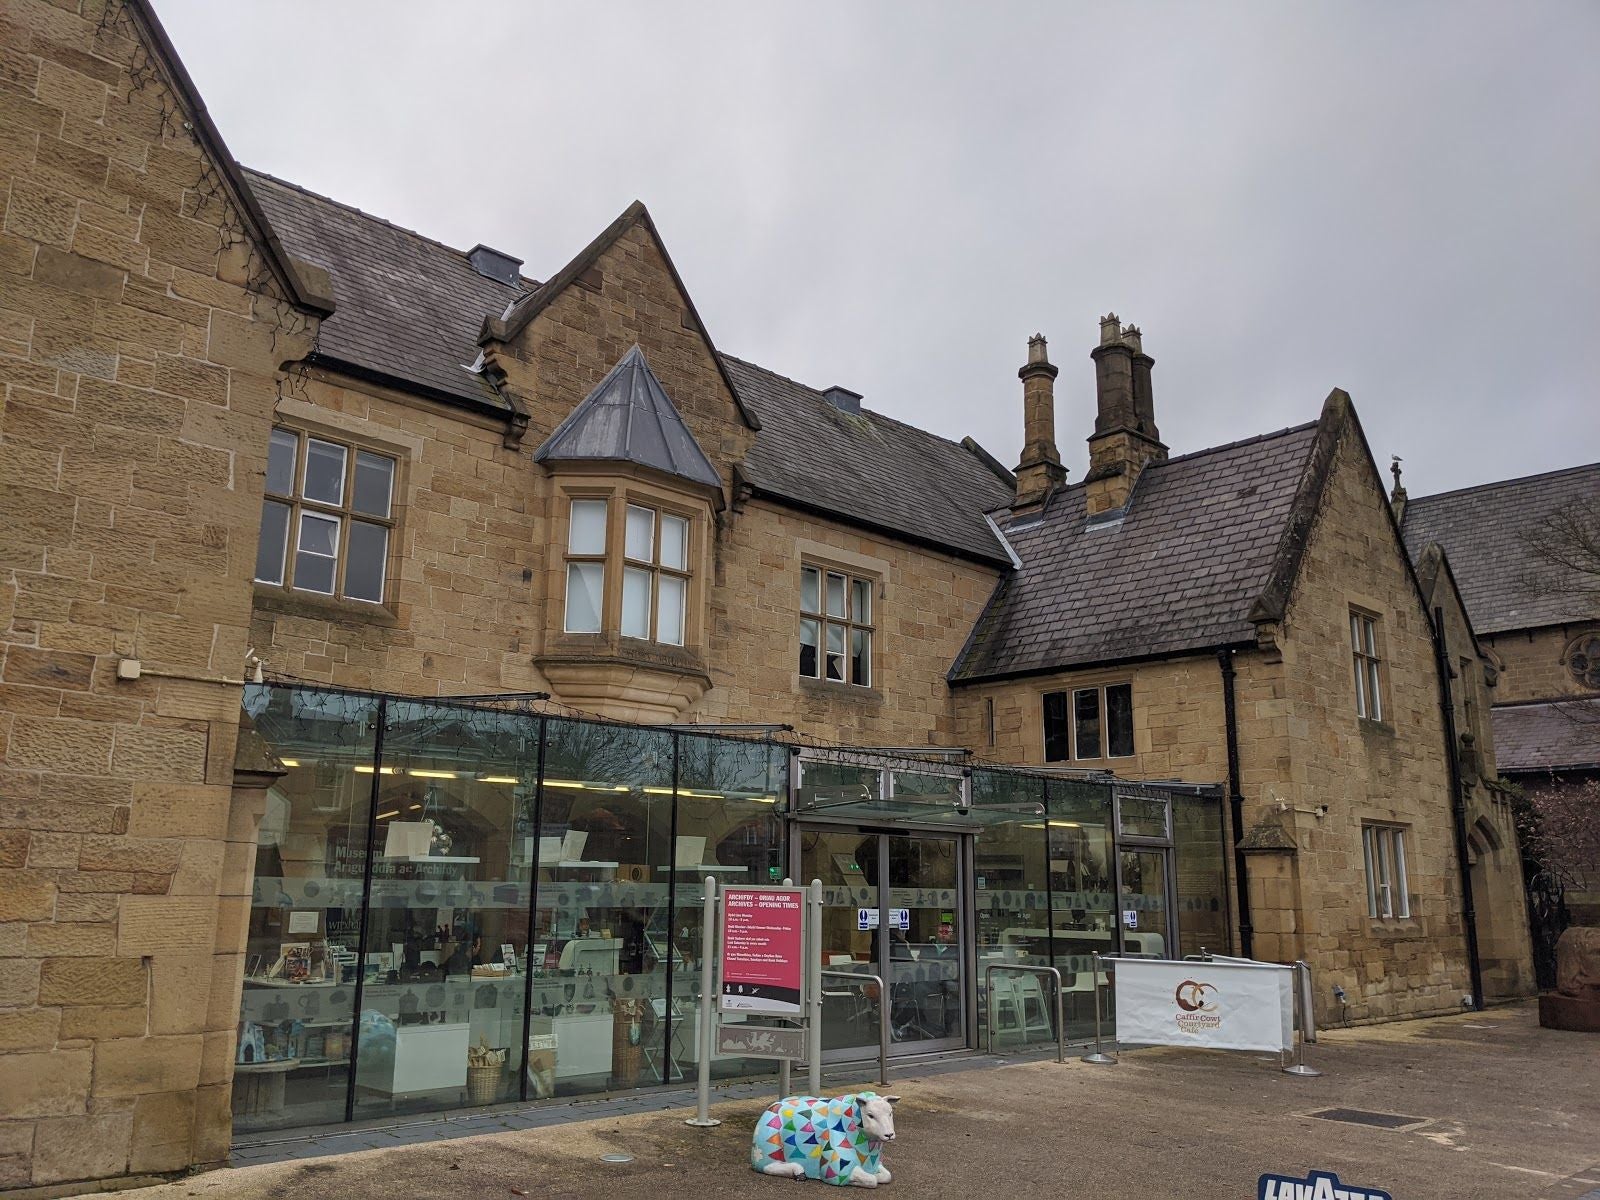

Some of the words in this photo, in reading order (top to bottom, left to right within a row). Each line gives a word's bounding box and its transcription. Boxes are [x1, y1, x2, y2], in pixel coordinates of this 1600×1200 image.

[335, 846, 383, 858] Musem
[334, 861, 396, 874] Amguddfa
[1178, 1020, 1220, 1028] Courtyard
[1264, 1177, 1385, 1200] LAVA
